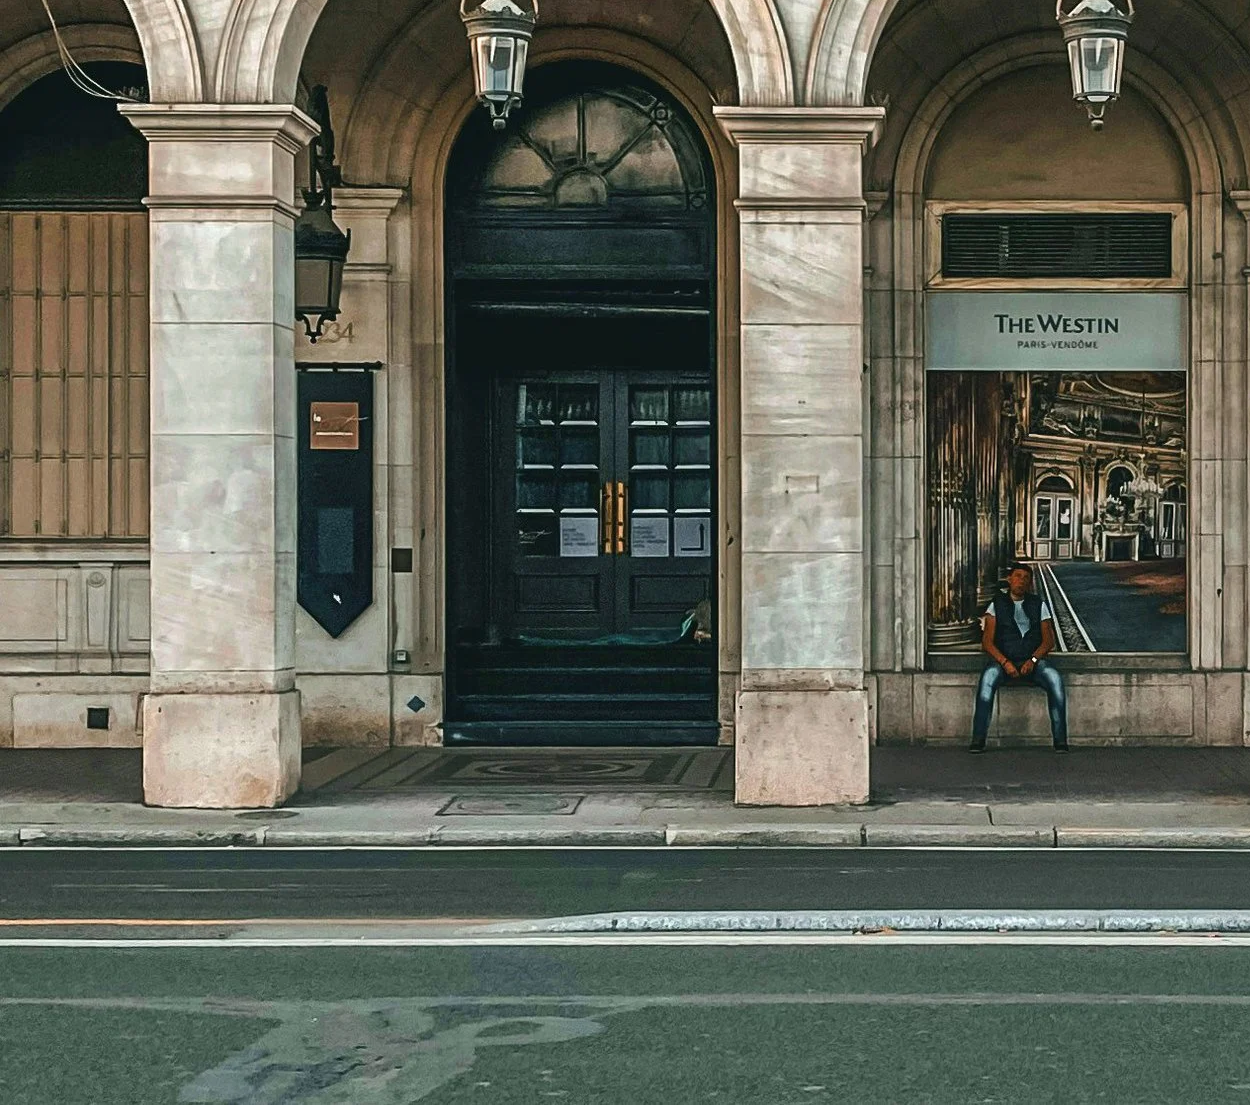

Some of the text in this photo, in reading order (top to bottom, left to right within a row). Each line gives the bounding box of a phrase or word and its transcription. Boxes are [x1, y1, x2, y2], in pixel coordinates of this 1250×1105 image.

[318, 322, 355, 343] 234
[993, 314, 1119, 334] THE WESTIN
[1017, 339, 1098, 349] PARIS-VENDÔME
